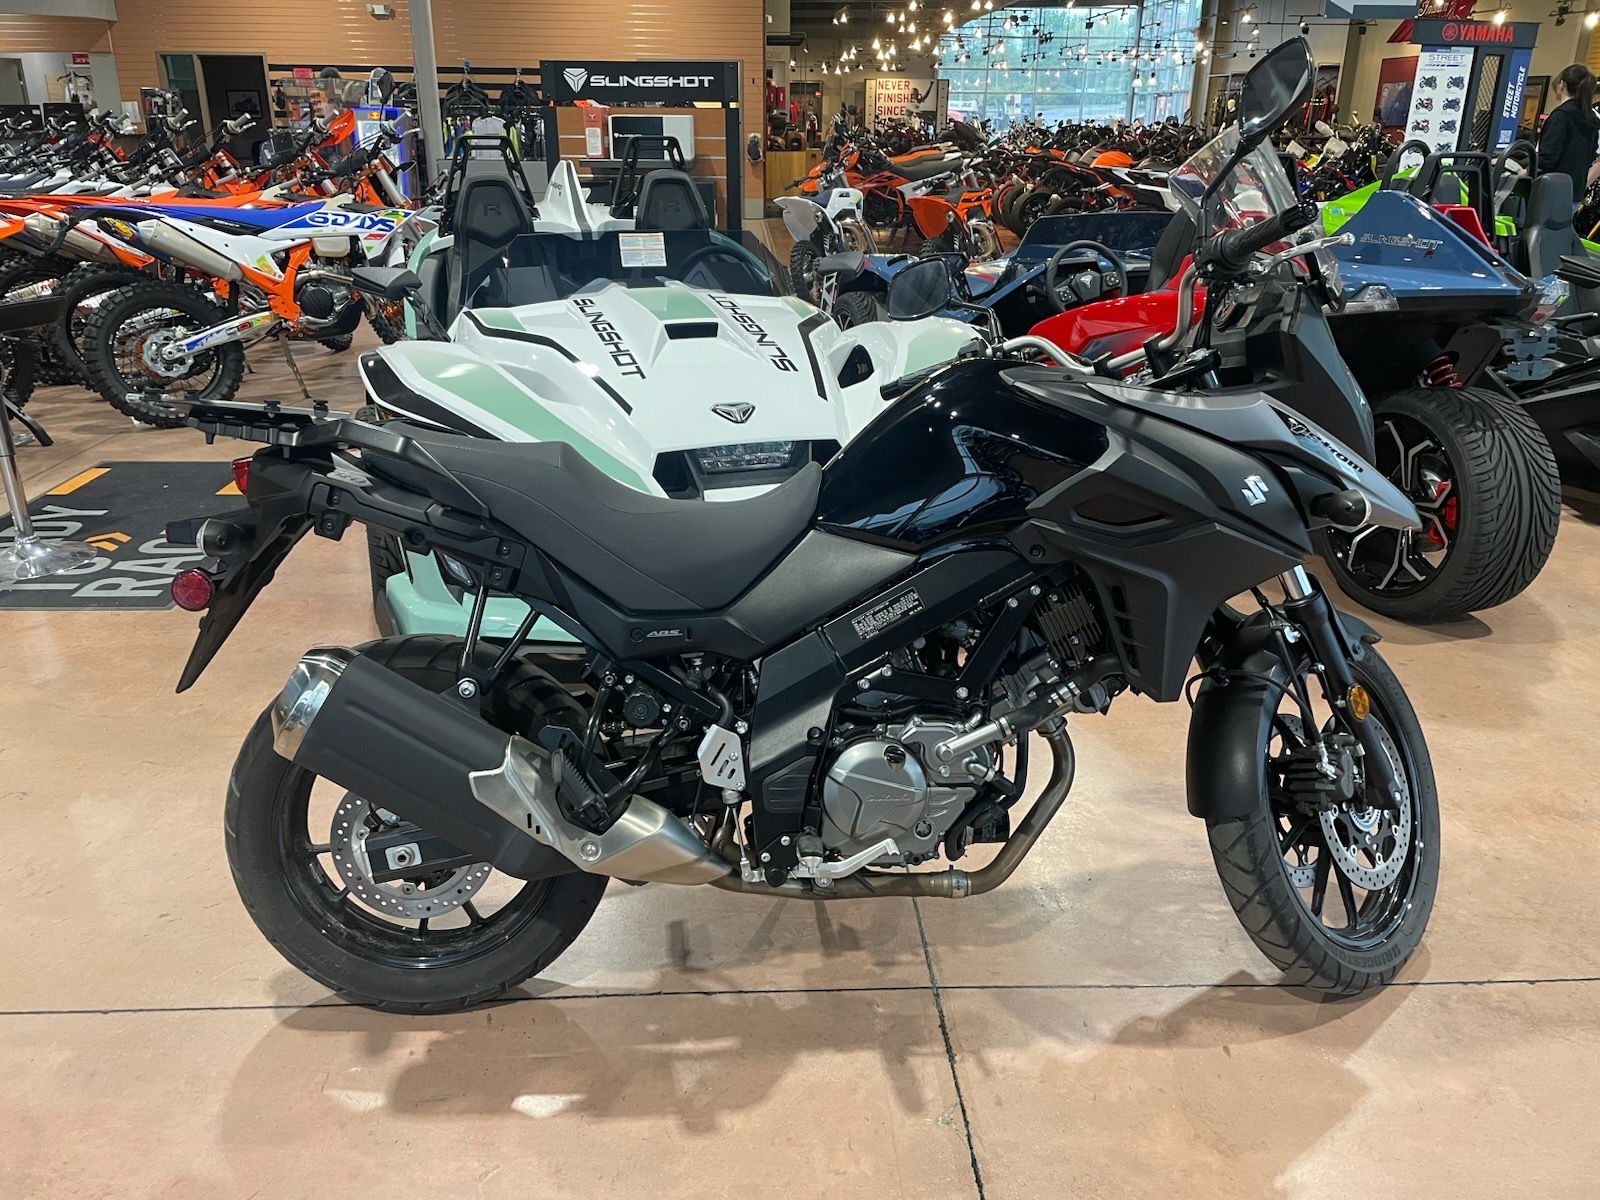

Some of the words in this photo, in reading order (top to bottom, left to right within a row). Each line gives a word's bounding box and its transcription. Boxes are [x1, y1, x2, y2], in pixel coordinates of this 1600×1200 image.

[1460, 24, 1513, 42] YAMAHA
[590, 75, 714, 88] SLINGSHOT
[878, 80, 911, 90] NEVER
[1503, 81, 1515, 118] STREET
[1510, 65, 1526, 119] MOTORCYCLE
[877, 106, 907, 116] SINCE
[1359, 232, 1444, 250] SLINGSHOT
[572, 298, 647, 380] SLINGSHOT
[707, 293, 799, 373] SLINGSHOT
[646, 629, 684, 638] ABS
